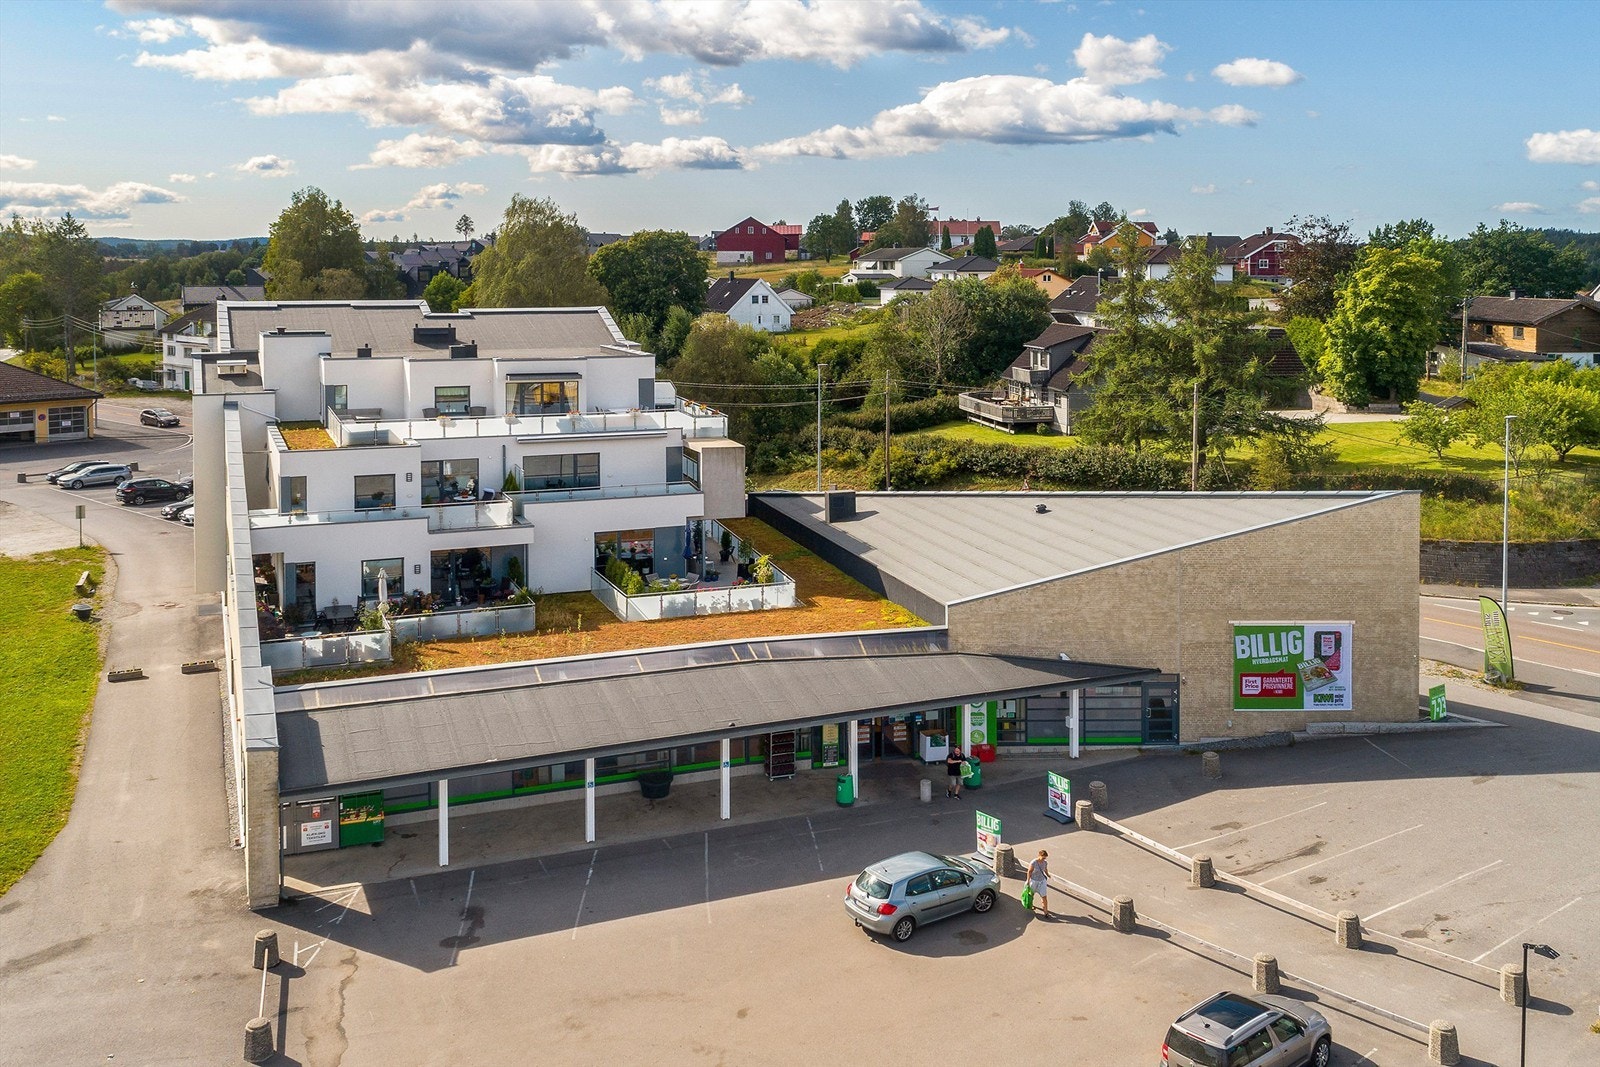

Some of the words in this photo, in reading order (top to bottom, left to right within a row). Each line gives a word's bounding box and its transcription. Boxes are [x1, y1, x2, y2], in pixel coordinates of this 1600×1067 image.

[1235, 630, 1303, 659] BILLIG
[1252, 656, 1289, 665] HVERDAGSMAT
[1297, 657, 1320, 670] BILLIG
[1262, 676, 1294, 684] GARANTERTE
[1313, 693, 1334, 703] KIWI
[1431, 696, 1446, 720] 7-23
[1049, 774, 1069, 789] BILLIG
[976, 814, 1000, 831] BILLIG
